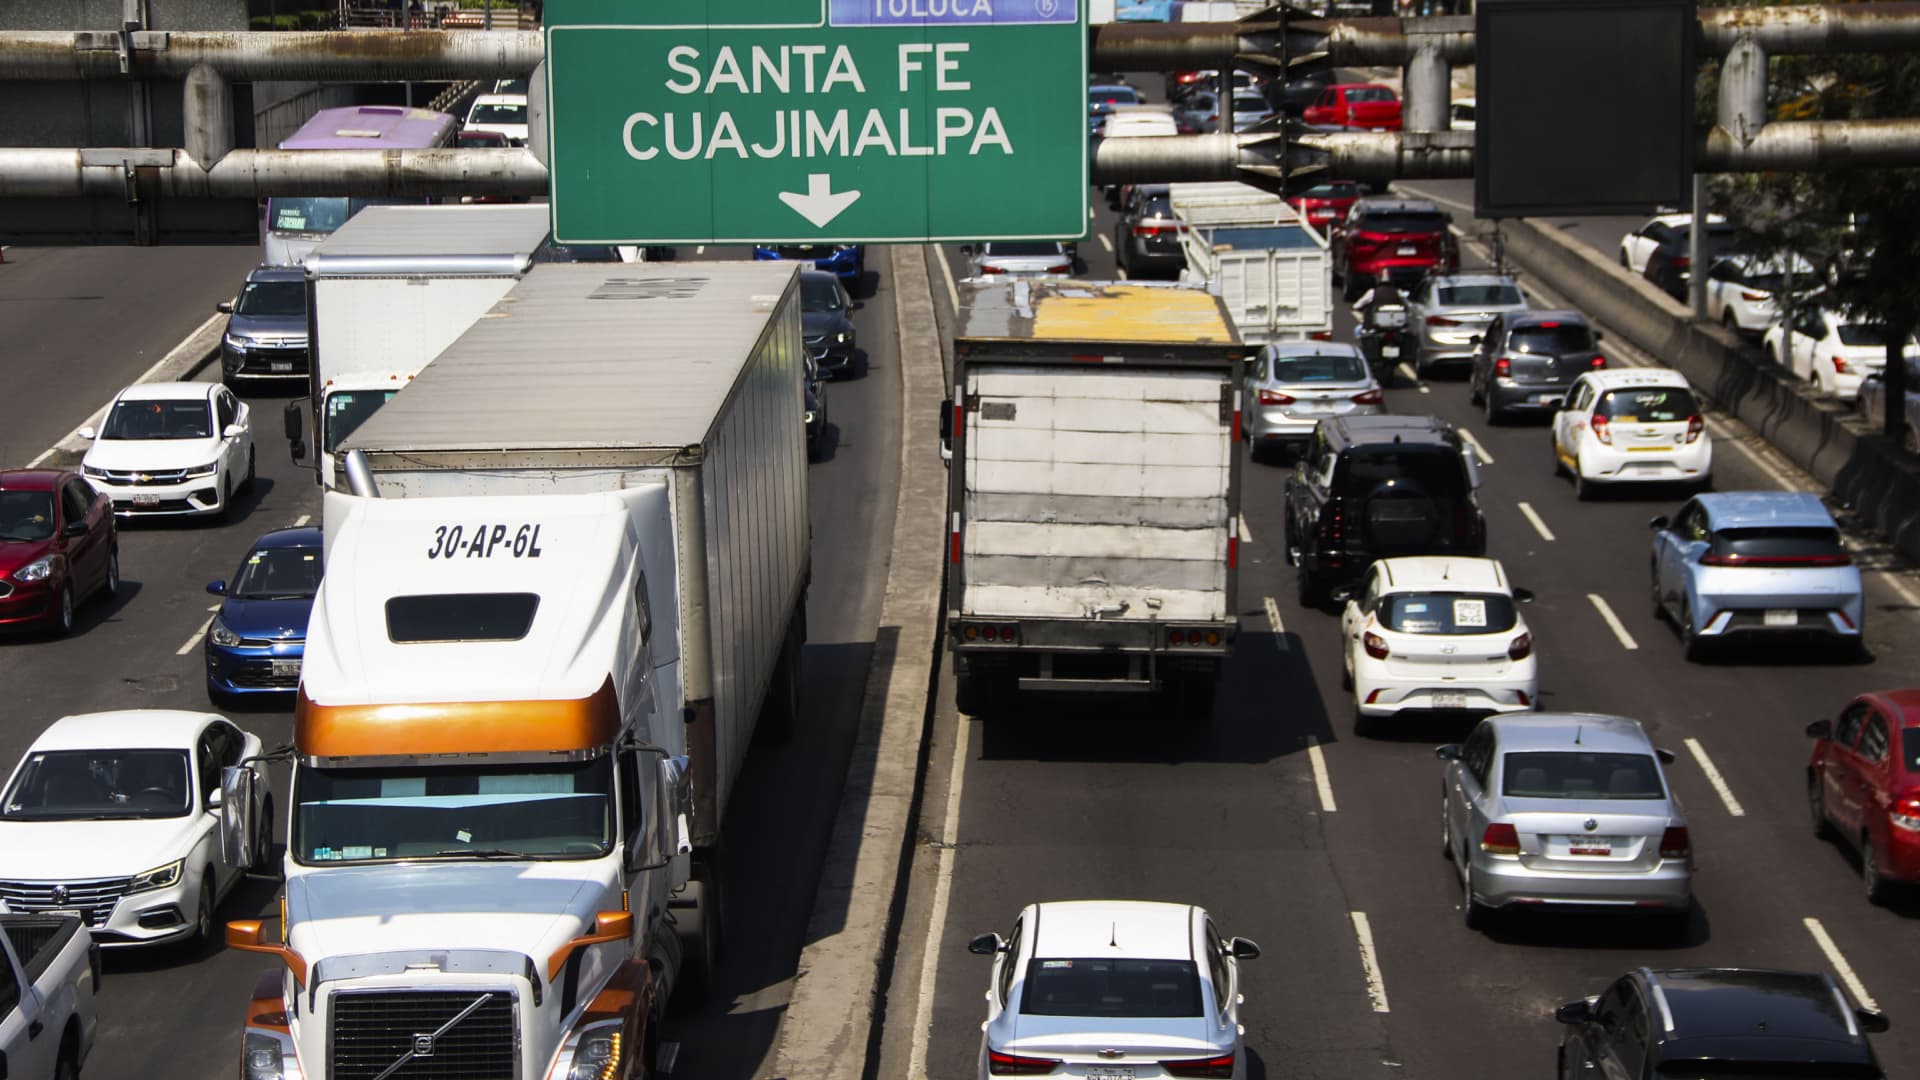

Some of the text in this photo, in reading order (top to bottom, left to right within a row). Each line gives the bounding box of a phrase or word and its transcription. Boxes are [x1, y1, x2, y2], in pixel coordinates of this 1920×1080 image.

[665, 42, 971, 94] SANTA FE
[622, 106, 1014, 161] CUAJIMALPA
[428, 524, 542, 560] 30-AP-6L
